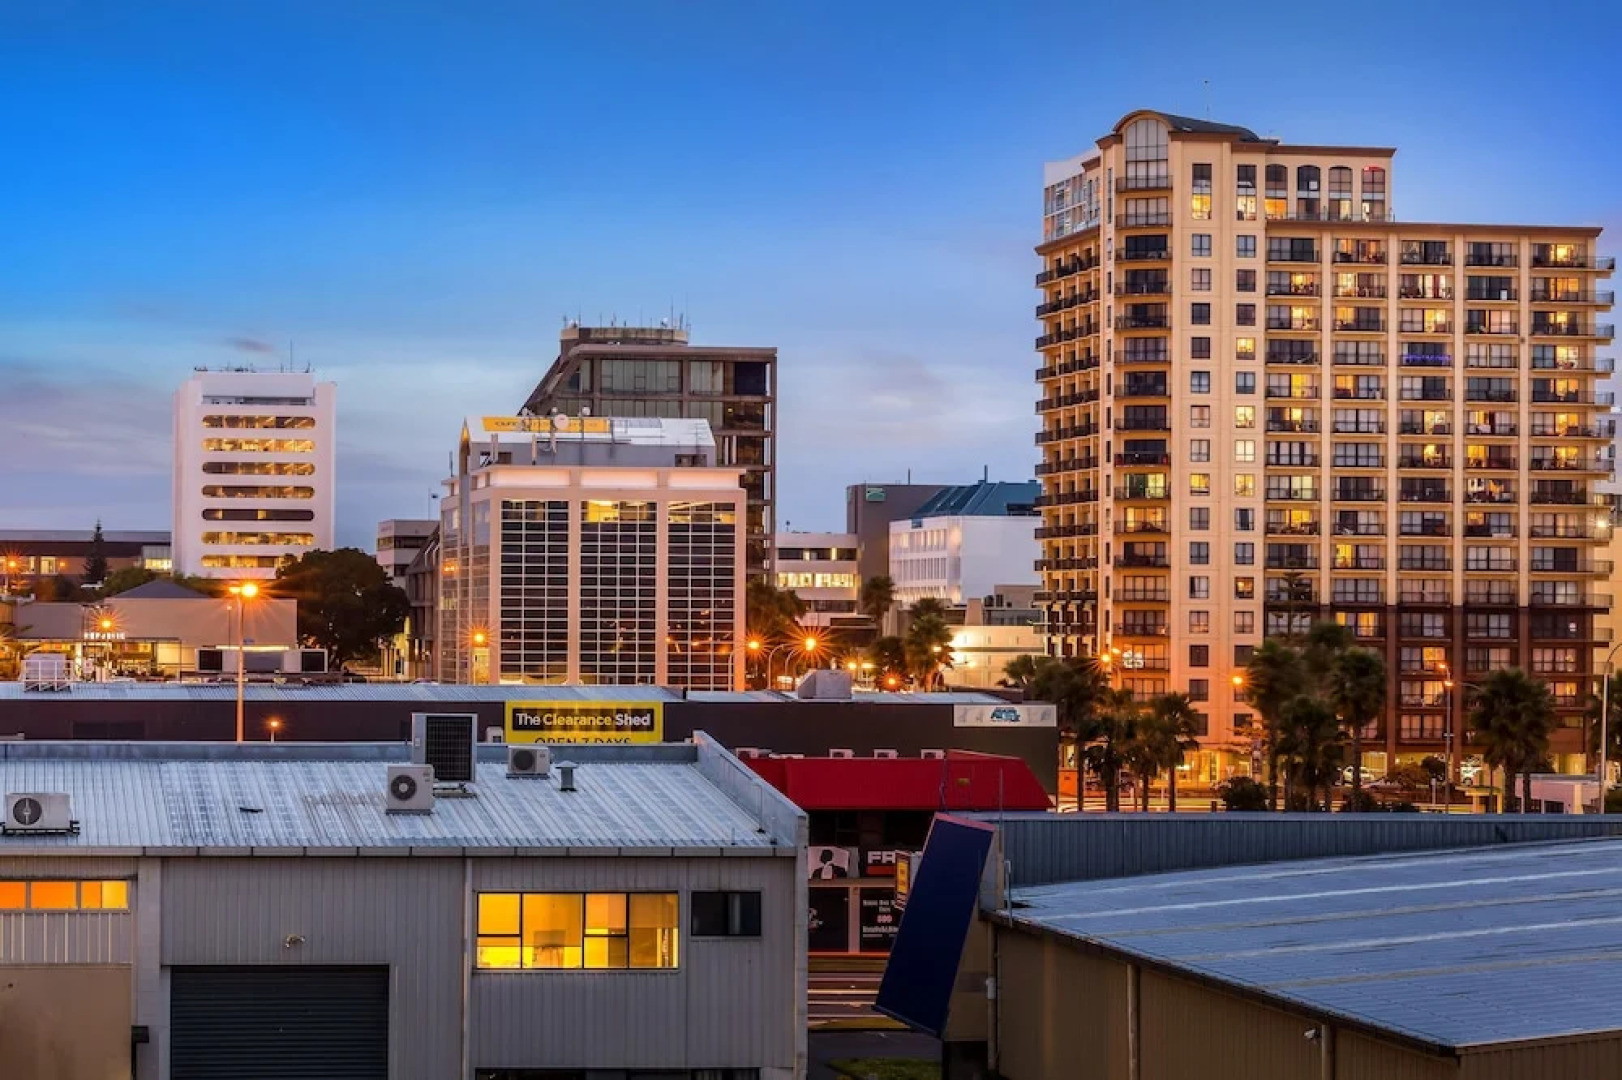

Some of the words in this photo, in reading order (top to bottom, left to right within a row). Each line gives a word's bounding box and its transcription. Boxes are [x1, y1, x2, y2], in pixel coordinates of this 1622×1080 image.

[516, 713, 541, 725] The
[543, 713, 611, 725] Clearance
[615, 713, 651, 725] Shed
